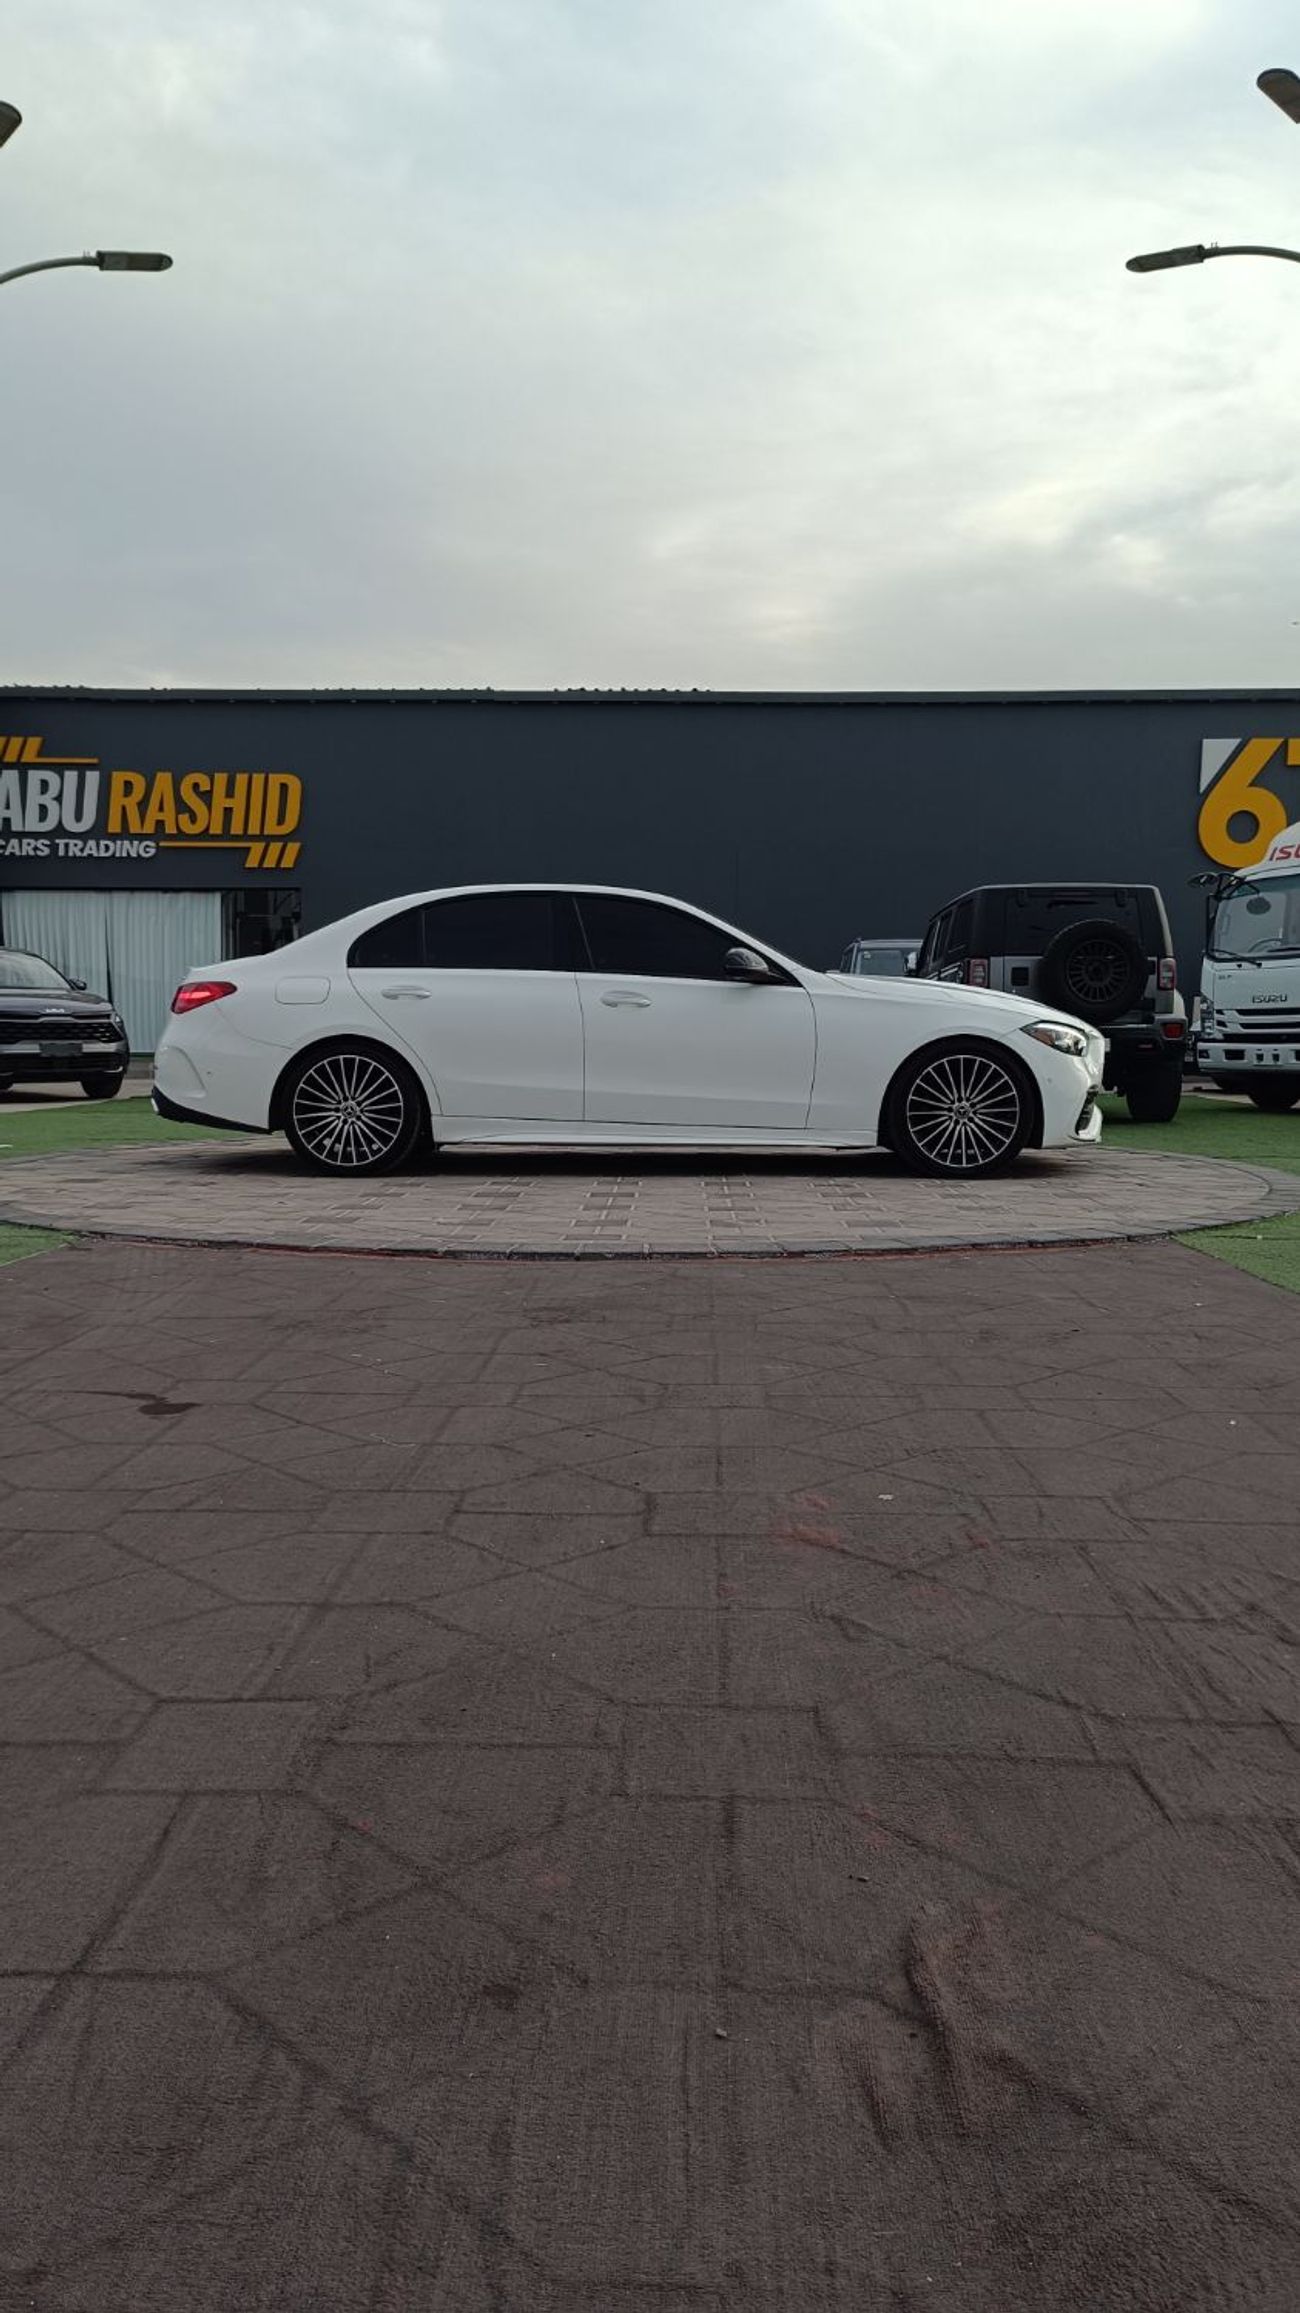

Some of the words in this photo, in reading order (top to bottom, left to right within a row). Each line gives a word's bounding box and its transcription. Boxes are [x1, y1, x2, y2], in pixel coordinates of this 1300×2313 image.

[0, 769, 100, 833] ABU
[107, 771, 302, 835] RASHID
[1198, 738, 1300, 869] 6
[55, 839, 157, 858] TRADING
[1252, 993, 1288, 1004] ISUZU
